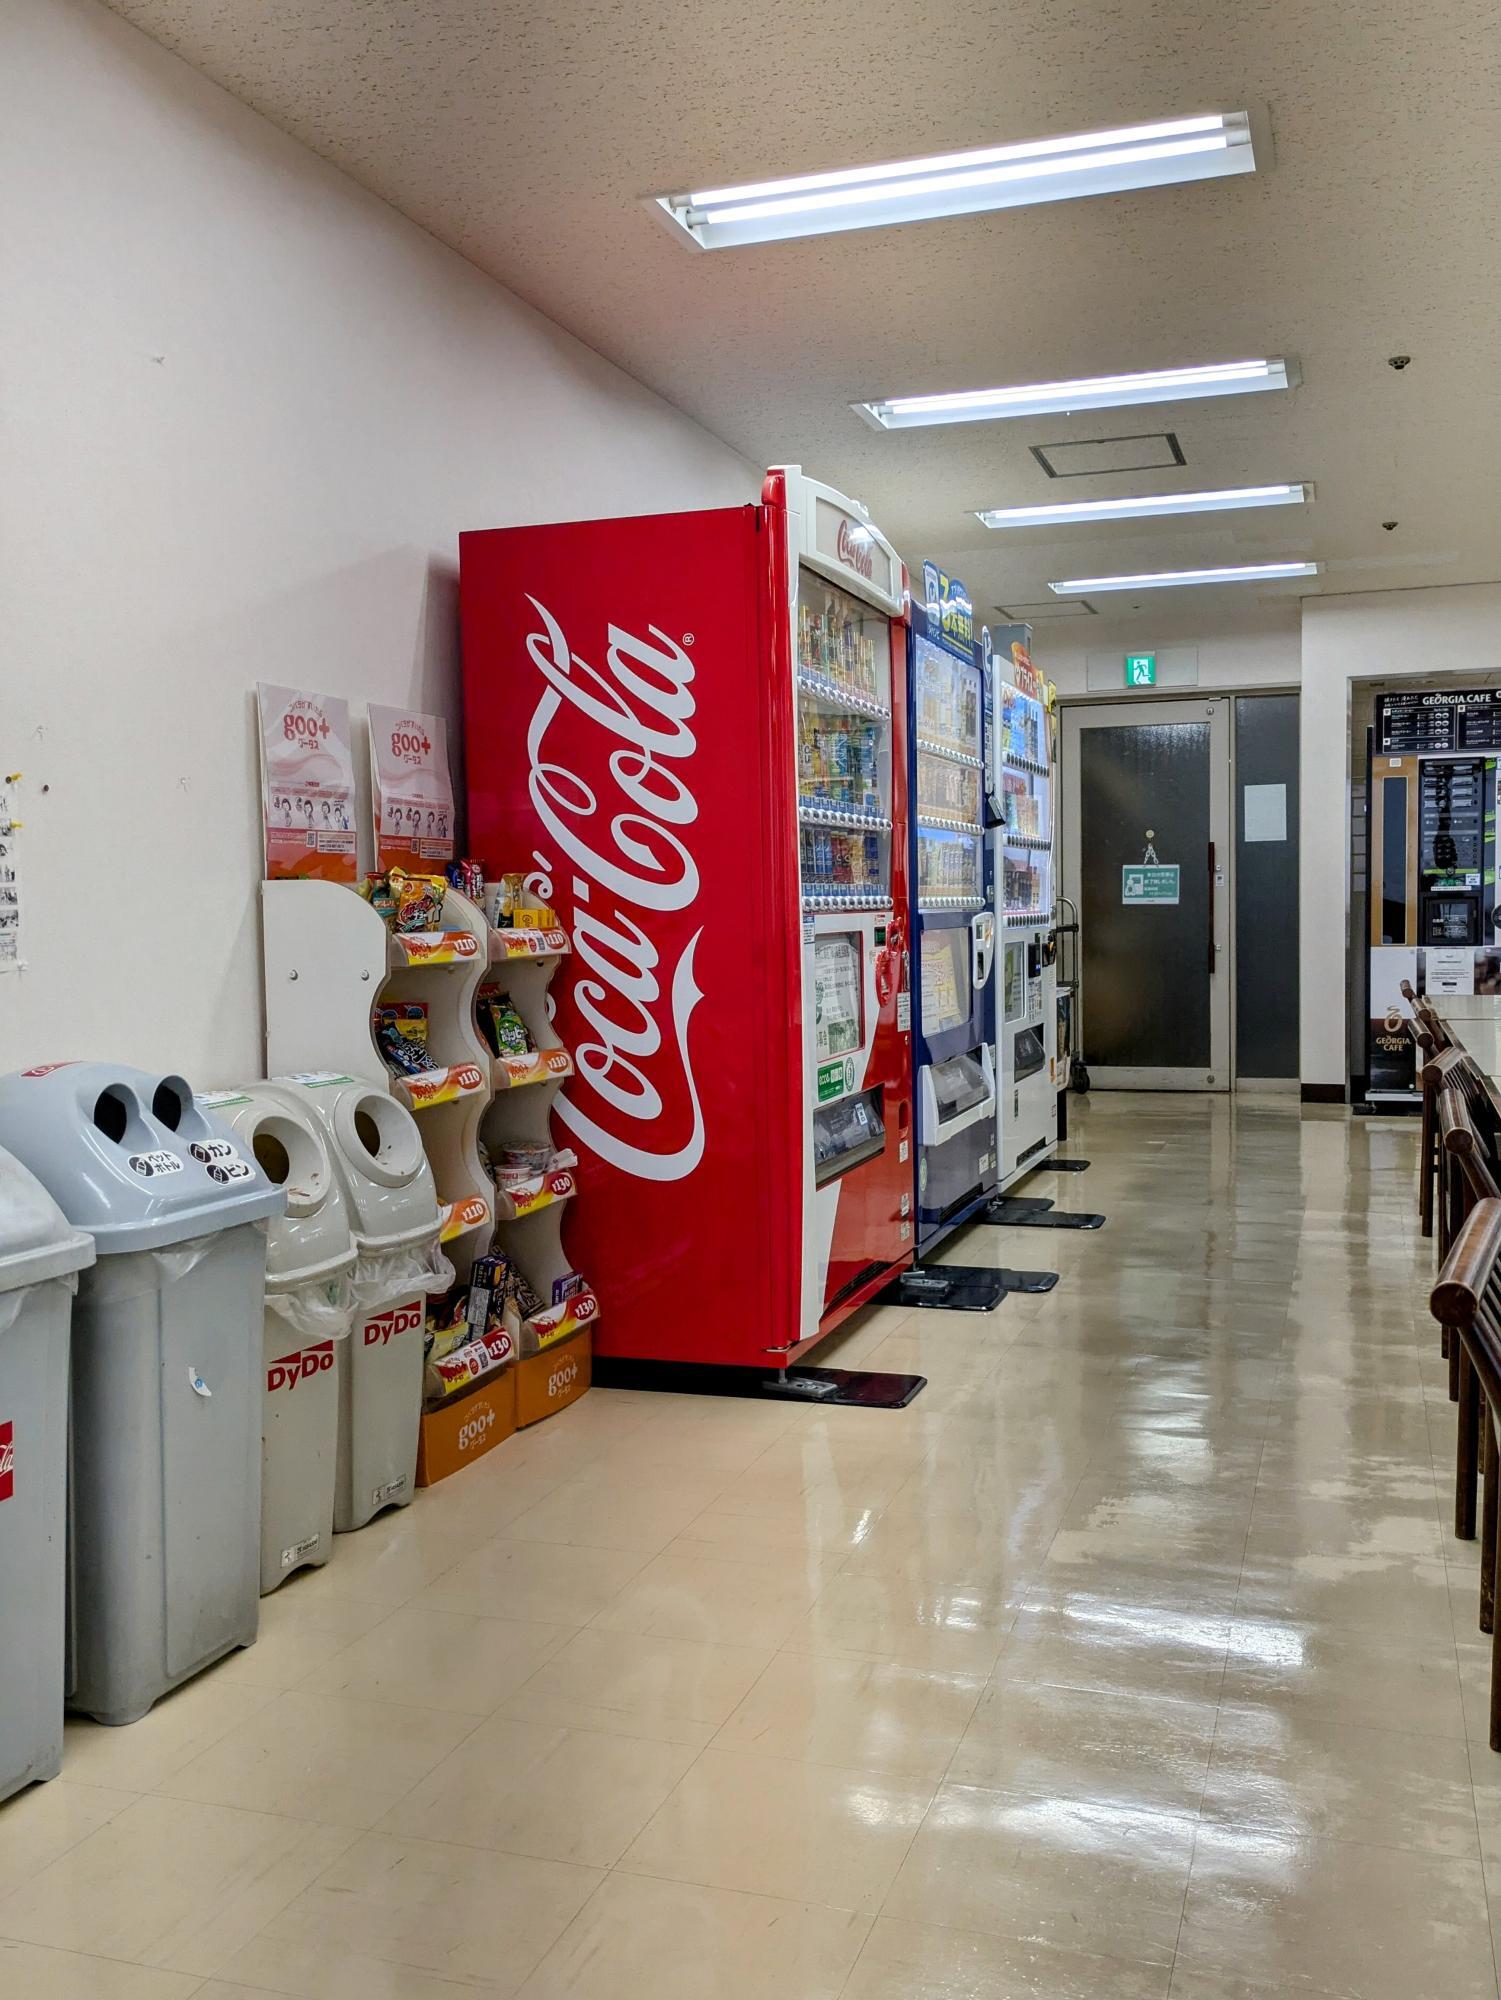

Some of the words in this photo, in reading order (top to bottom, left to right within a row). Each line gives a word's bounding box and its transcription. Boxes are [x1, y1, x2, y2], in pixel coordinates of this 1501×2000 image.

[1422, 694, 1465, 705] GEORGIA
[1466, 693, 1491, 703] CAFE
[524, 592, 705, 1181] Coca-Cola
[1376, 1036, 1411, 1045] GEORGIA
[1383, 1043, 1403, 1052] CAFE
[547, 1056, 566, 1069] ¥110
[459, 1073, 480, 1086] ¥110
[148, 1152, 172, 1163] ペット
[208, 1144, 231, 1157] カン
[154, 1162, 180, 1173] ボトル
[224, 1164, 249, 1177] ビン
[552, 1176, 572, 1194] ¥130
[462, 1202, 484, 1220] ¥110
[575, 1300, 594, 1318] ¥130
[364, 1311, 421, 1346] DyDo
[488, 1338, 509, 1358] ¥130
[268, 1351, 333, 1391] DyDo
[548, 1363, 578, 1397] goo+
[458, 1408, 495, 1450] goo+
